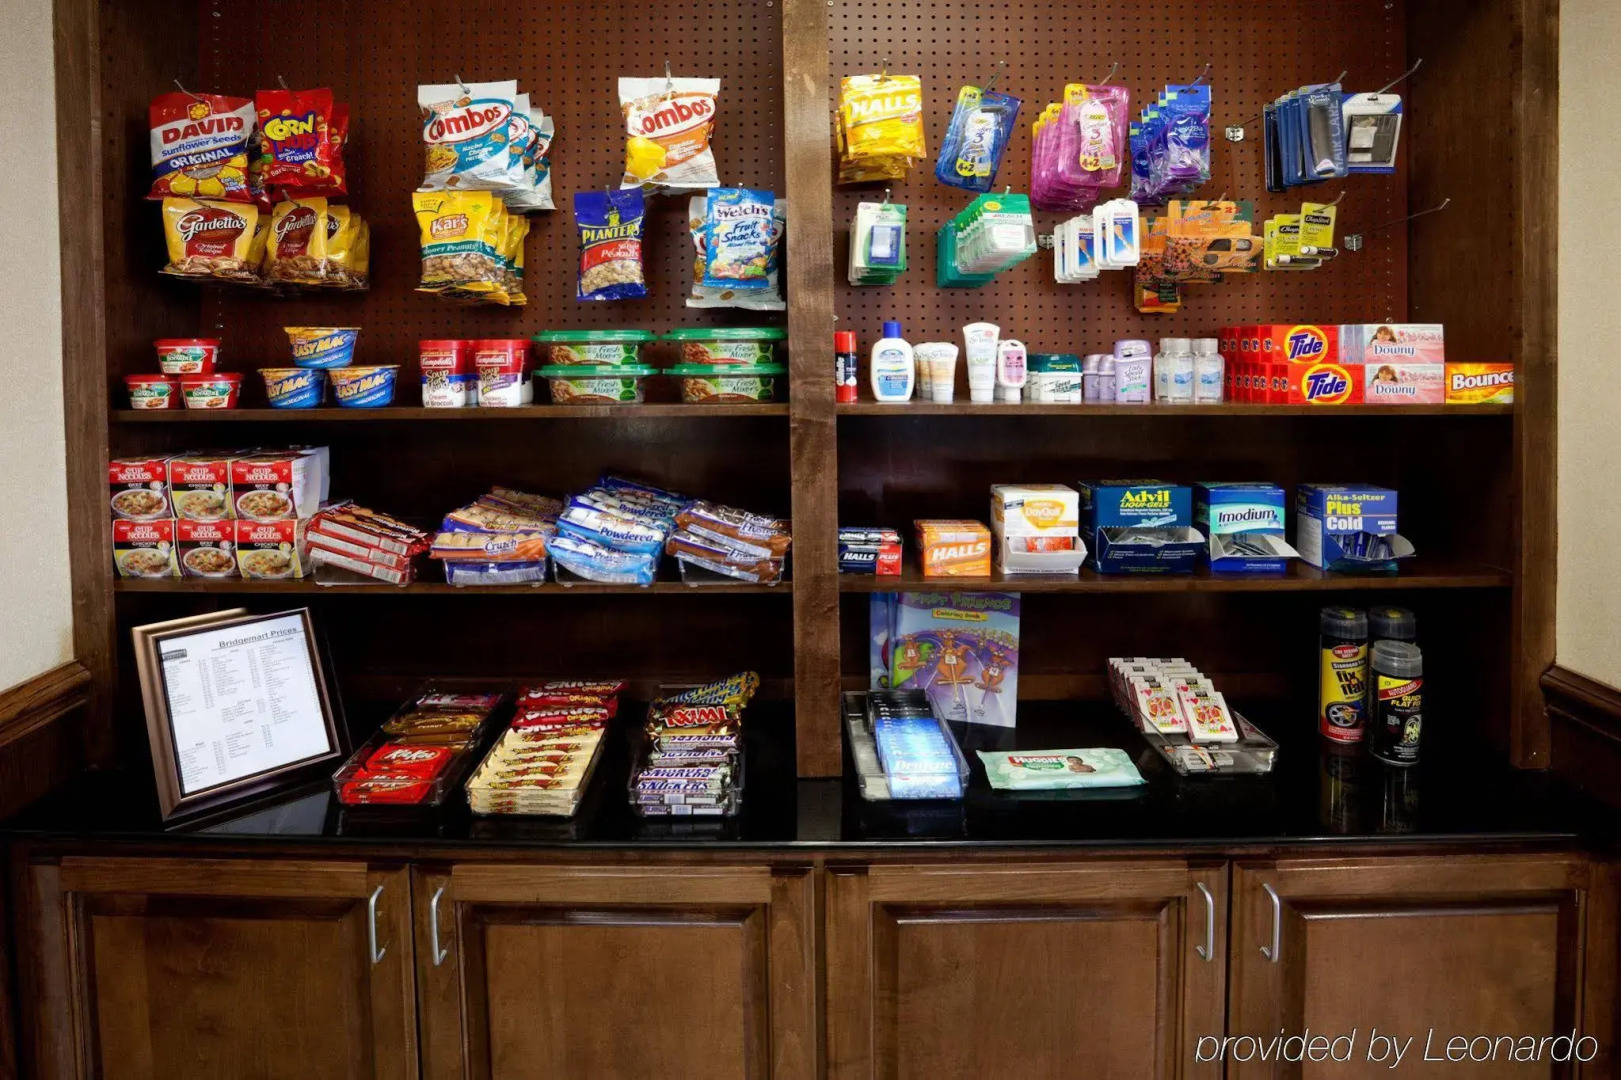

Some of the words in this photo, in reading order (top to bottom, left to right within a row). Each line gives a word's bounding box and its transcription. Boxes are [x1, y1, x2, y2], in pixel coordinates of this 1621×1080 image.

[851, 94, 917, 119] HALLS
[162, 116, 244, 145] DAVID
[264, 114, 315, 142] CORN
[428, 106, 502, 141] Combos
[1090, 128, 1101, 140] 3
[161, 139, 211, 157] Sunflower
[212, 134, 242, 145] Seeds
[169, 147, 234, 169] ORIGINAL
[957, 163, 975, 172] 4+2
[717, 204, 769, 218] Welch's
[176, 213, 247, 242] Gardetto's
[431, 214, 468, 234] Kar's
[732, 220, 758, 234] Fruit
[582, 223, 640, 245] PLANTERS
[720, 230, 761, 243] Snacks
[294, 342, 317, 357] EASY
[316, 335, 347, 352] MAC
[599, 345, 620, 354] Fresh
[734, 343, 757, 352] Fresh
[1288, 332, 1323, 360] Tide
[1373, 345, 1415, 356] Downy
[422, 357, 453, 366] Campbell's
[475, 354, 506, 364] Campbell's
[730, 350, 758, 359] Mixers
[426, 369, 449, 379] Soup
[1451, 371, 1514, 391] Bounce
[281, 374, 312, 393] MAC
[337, 383, 360, 398] EASY
[358, 373, 388, 392] MAC
[596, 380, 618, 388] Fresh
[732, 385, 759, 393] Mixers
[735, 378, 758, 387] Fresh
[1306, 372, 1347, 401] Tide
[592, 386, 620, 394] Mixers
[1375, 384, 1416, 396] Downy
[1120, 490, 1170, 503] Advil
[1025, 508, 1061, 518] DayQuil
[1327, 501, 1361, 515] Plus
[1218, 508, 1275, 523] Imodium
[1327, 516, 1363, 530] Cold
[600, 526, 654, 541] Powdered
[932, 543, 986, 561] HALLS
[935, 610, 963, 618] Coloring
[218, 632, 269, 648] Bridgemart
[270, 627, 298, 640] Prices
[1336, 671, 1356, 682] fix
[1388, 682, 1417, 696] AUTOGUARD
[1391, 699, 1411, 707] FLAT
